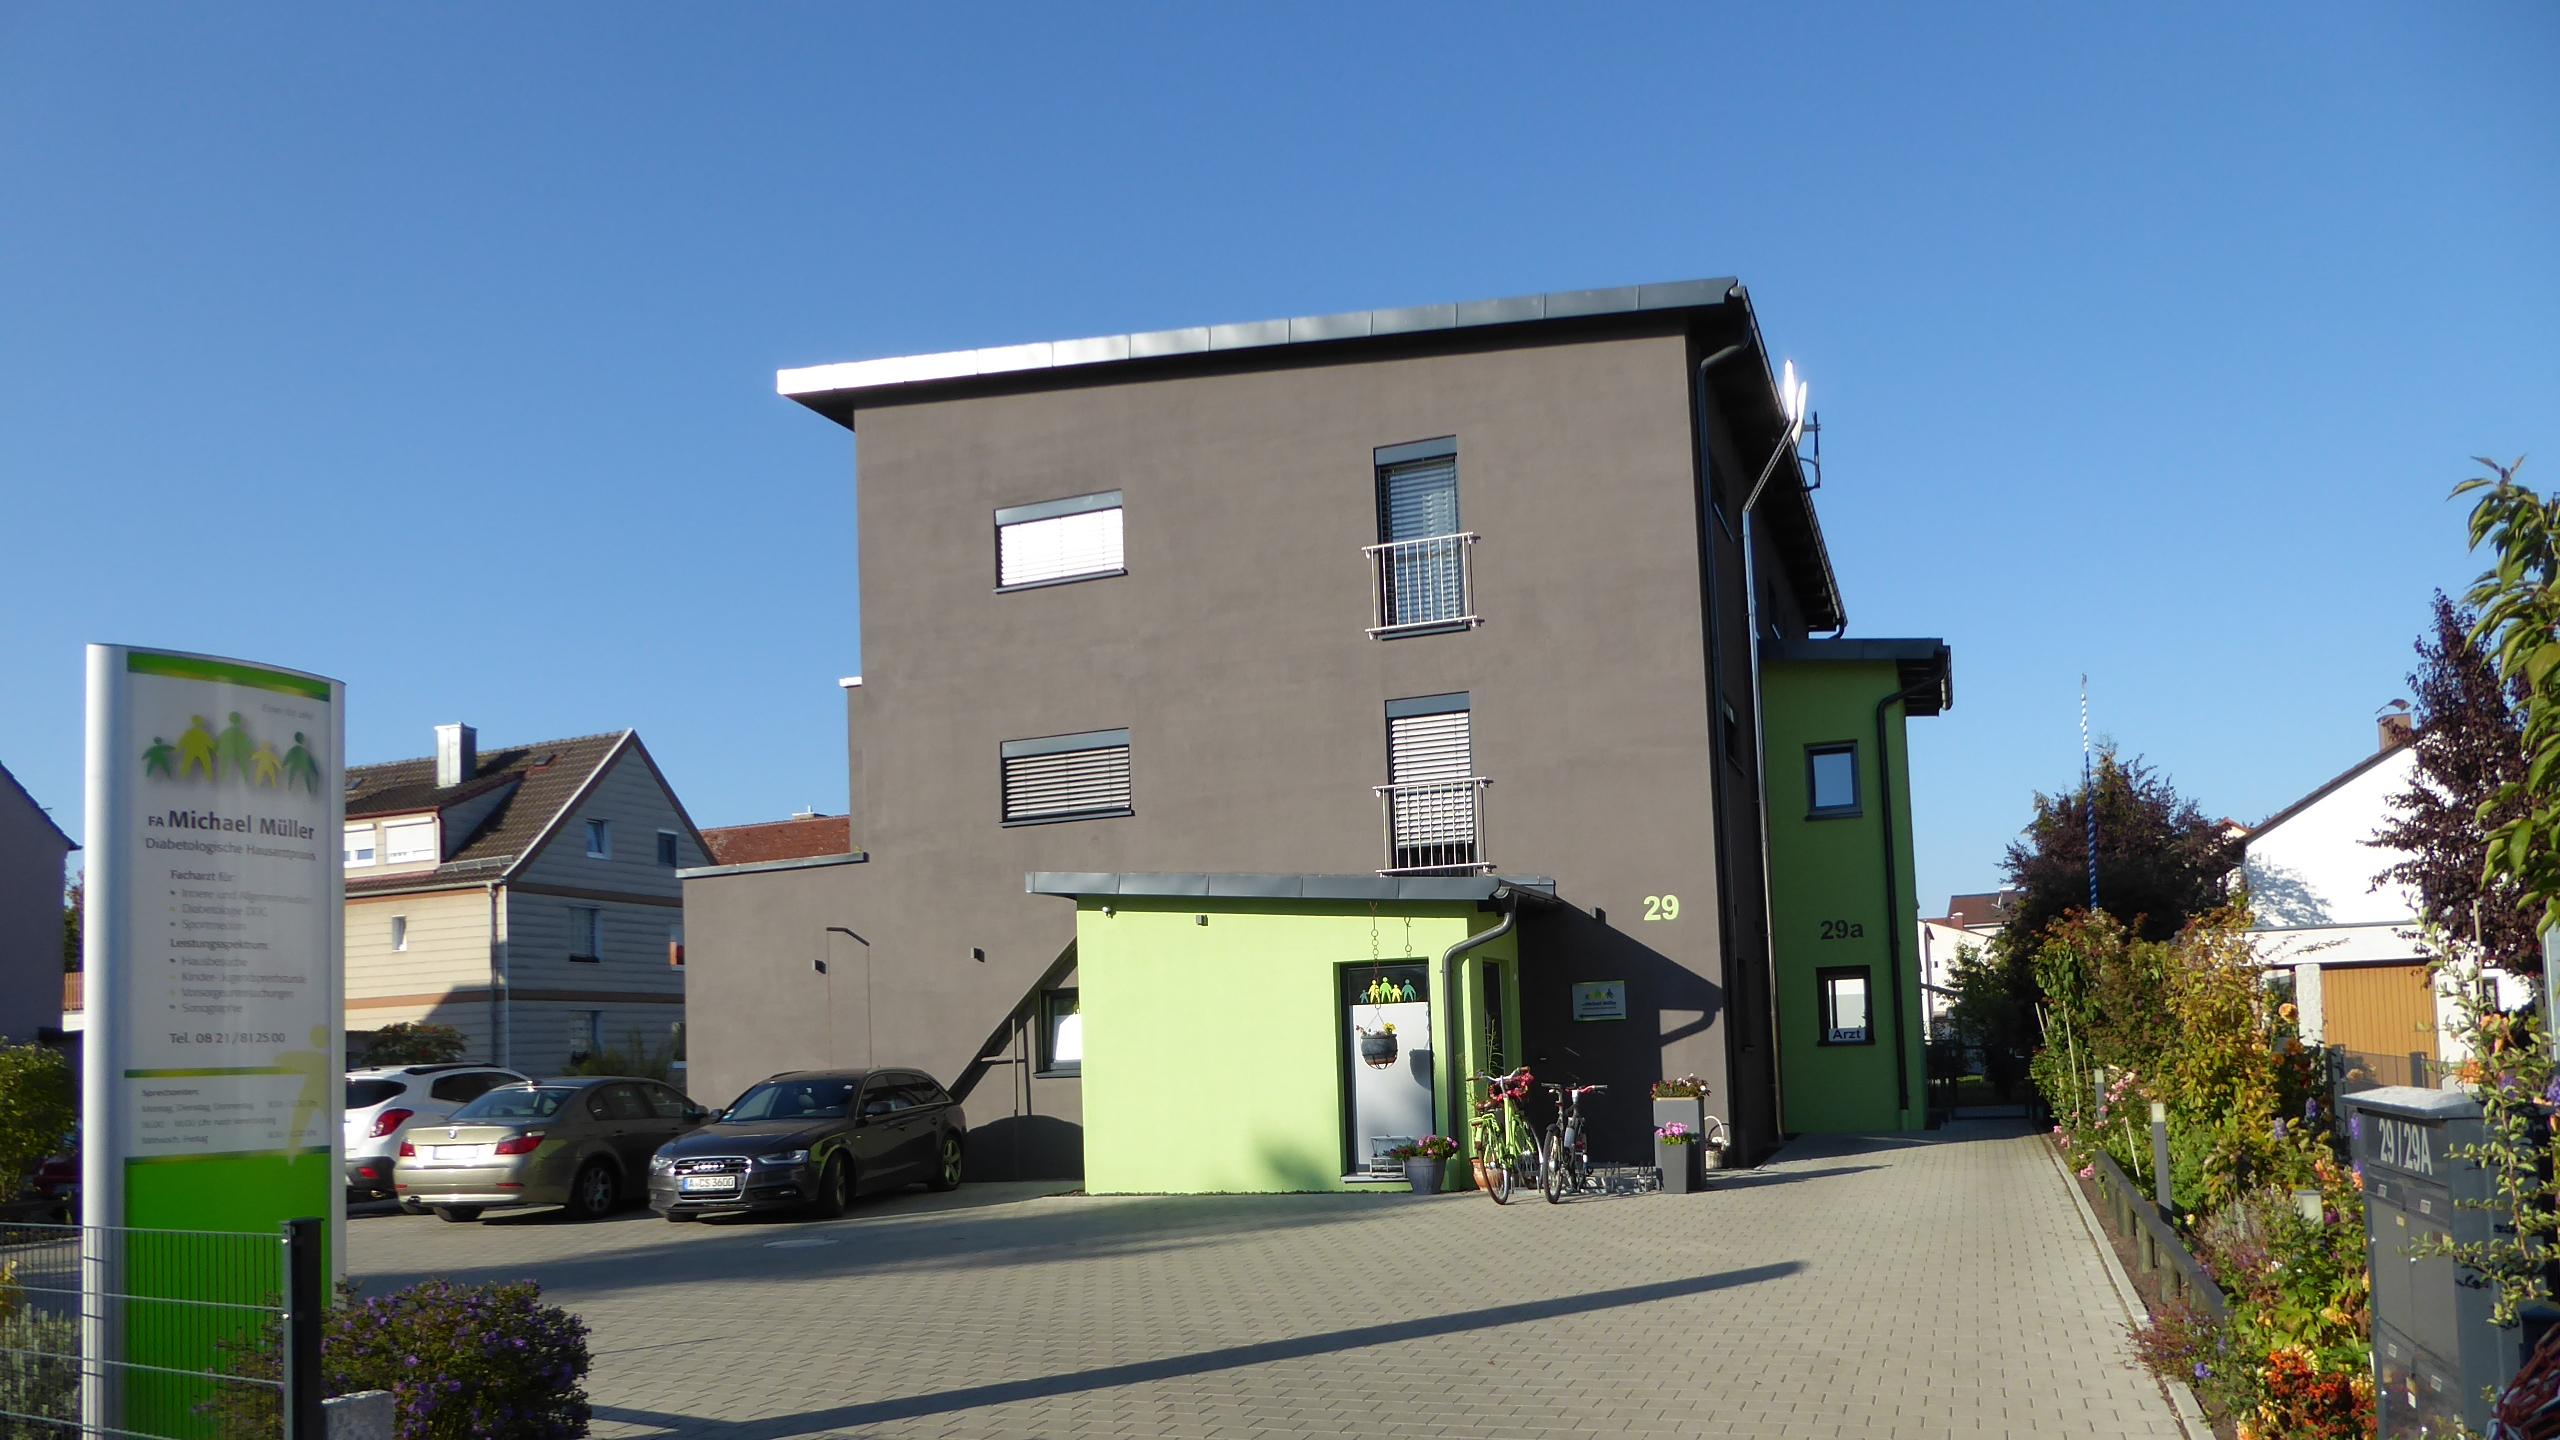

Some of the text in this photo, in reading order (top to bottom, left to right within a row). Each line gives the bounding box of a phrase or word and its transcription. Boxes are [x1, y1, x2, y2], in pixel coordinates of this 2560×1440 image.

[148, 809, 315, 840] FA Michael Müller
[169, 869, 216, 882] Facharzt
[1643, 894, 1680, 921] 29
[1820, 919, 1864, 940] 29a
[1832, 1029, 1862, 1040] Arzt
[2379, 1118, 2395, 1164] 29
[2403, 1122, 2433, 1176] 29A
